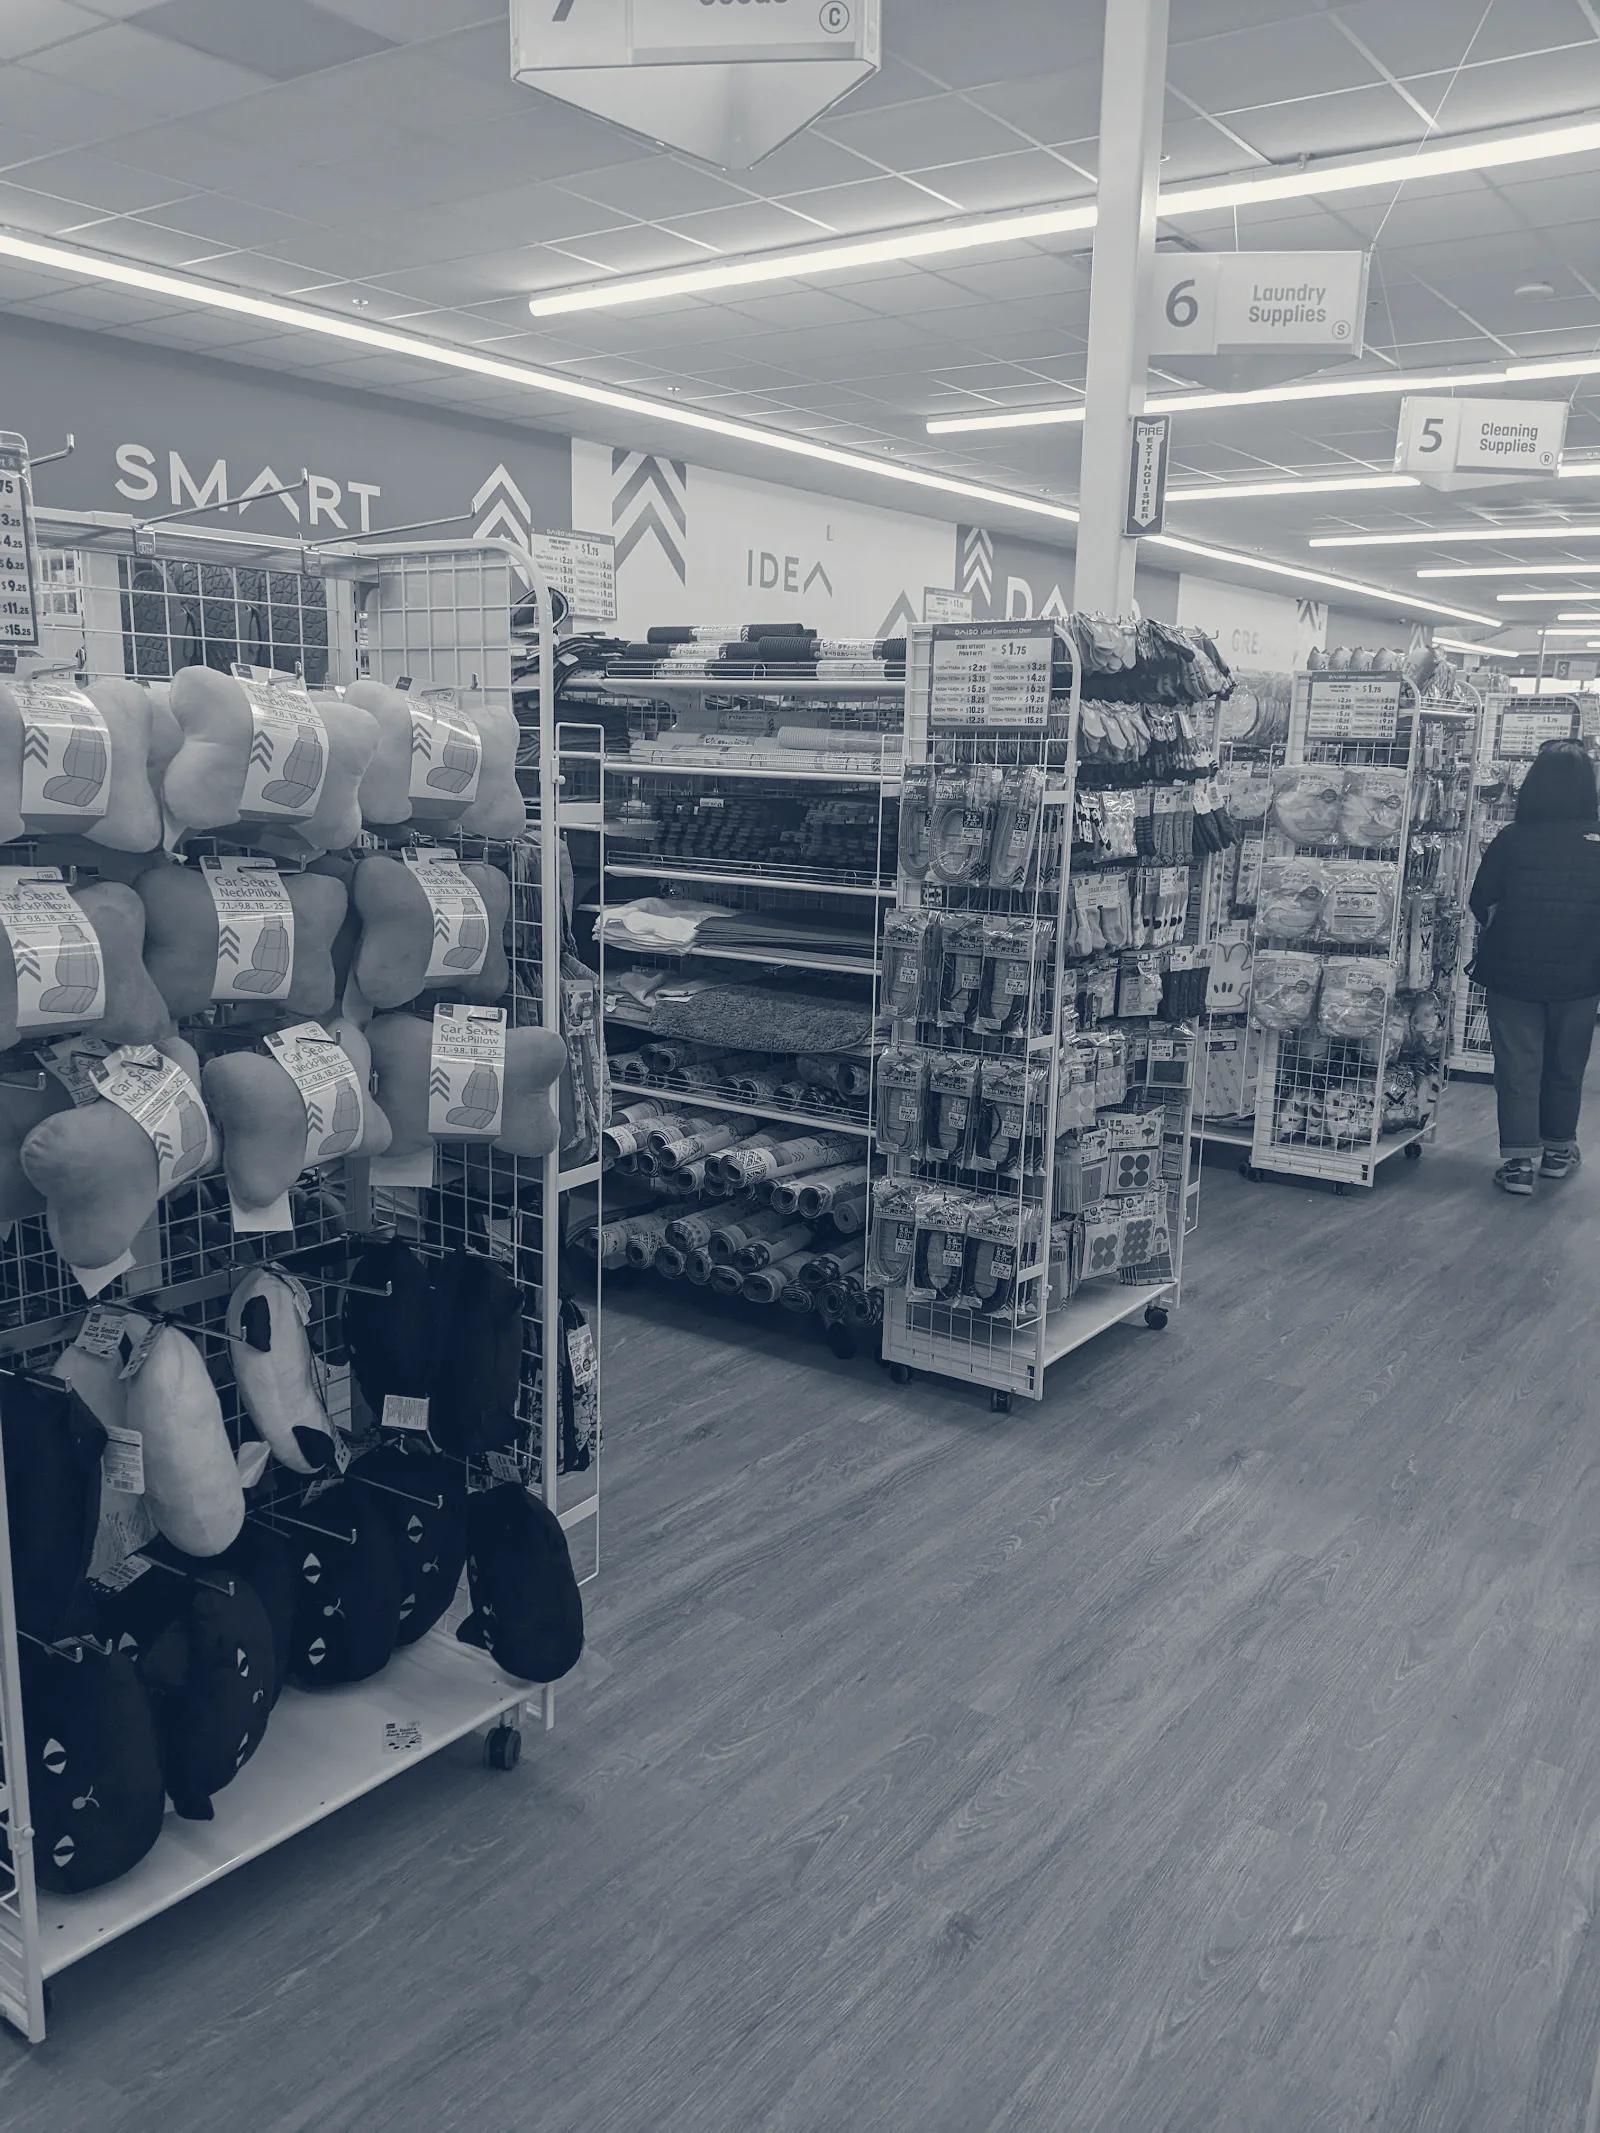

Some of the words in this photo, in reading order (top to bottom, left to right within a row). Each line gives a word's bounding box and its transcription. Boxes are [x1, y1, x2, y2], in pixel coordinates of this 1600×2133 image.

[1252, 283, 1326, 305] Laundry
[1166, 279, 1198, 327] 6
[1248, 304, 1326, 327] Supplies
[1138, 427, 1164, 436] FIRE
[1418, 418, 1444, 453] 5
[1481, 422, 1538, 441] Cleaning
[1479, 438, 1536, 455] Supplies
[1141, 437, 1154, 519] EXTINGUISHER
[114, 443, 381, 532] SMART
[581, 543, 599, 557] $1.75
[1, 579, 27, 592] $9.25
[2, 601, 30, 615] $11.25
[4, 623, 31, 636] $15.25
[955, 628, 979, 636] DAISO
[1001, 641, 1027, 657] $1.75
[968, 663, 987, 672] $2.25
[1027, 662, 1047, 671] $3.25
[968, 674, 986, 683] $3.75
[1026, 673, 1046, 682] $4.25
[967, 684, 986, 693] $5.25
[1026, 684, 1046, 692] $6.25
[1362, 684, 1382, 693] $1.75
[966, 695, 985, 704] $8.25
[1025, 694, 1045, 703] $9.25
[965, 705, 985, 714] $10.25
[1024, 705, 1044, 714] $11.25
[965, 716, 985, 724] $12.25
[1024, 716, 1044, 724] $15.25
[415, 867, 432, 876] Car
[433, 868, 462, 878] Seats
[214, 877, 237, 888] Car
[241, 877, 278, 888] Seats
[422, 877, 468, 885] NeckPillow
[26, 891, 66, 901] Seats
[219, 888, 282, 898] NeckPillow
[4, 901, 73, 911] NeckPillow
[440, 1023, 463, 1034] Car
[465, 1025, 500, 1036] Seats
[440, 1034, 499, 1045] NeckPillow
[282, 1051, 303, 1064] Car
[301, 1041, 334, 1057] Seats
[291, 1052, 341, 1075] NeckPillow
[109, 1076, 134, 1098] Car
[122, 1065, 174, 1106] NeckPillow
[100, 1326, 120, 1335] Seats
